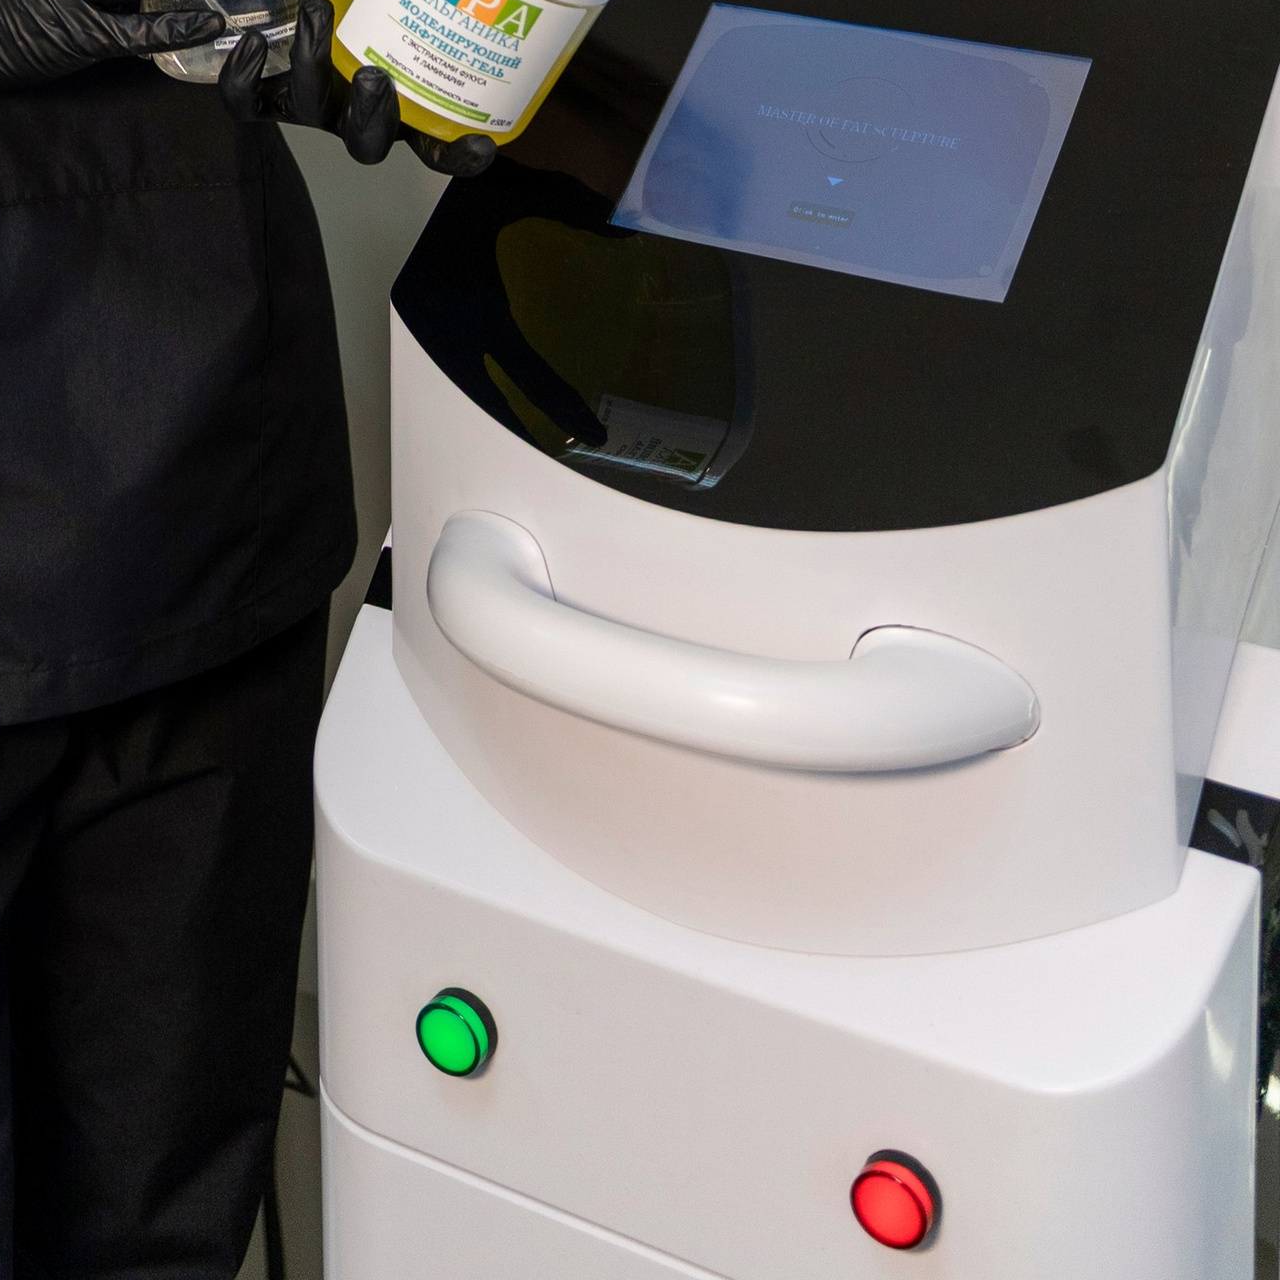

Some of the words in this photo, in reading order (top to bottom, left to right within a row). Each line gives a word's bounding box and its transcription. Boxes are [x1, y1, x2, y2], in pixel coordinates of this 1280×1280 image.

[399, 15, 505, 79] ЛИФТИНГ-ГЕЛЬ
[408, 40, 458, 74] ЭКСТРАКТАМИ
[459, 68, 488, 87] ФУКУСА
[420, 58, 466, 88] ЛАМИНАРИИ
[757, 104, 816, 125] MASTER
[819, 116, 840, 128] OF
[841, 119, 872, 134] FAT
[872, 125, 961, 151] SCULPTURE
